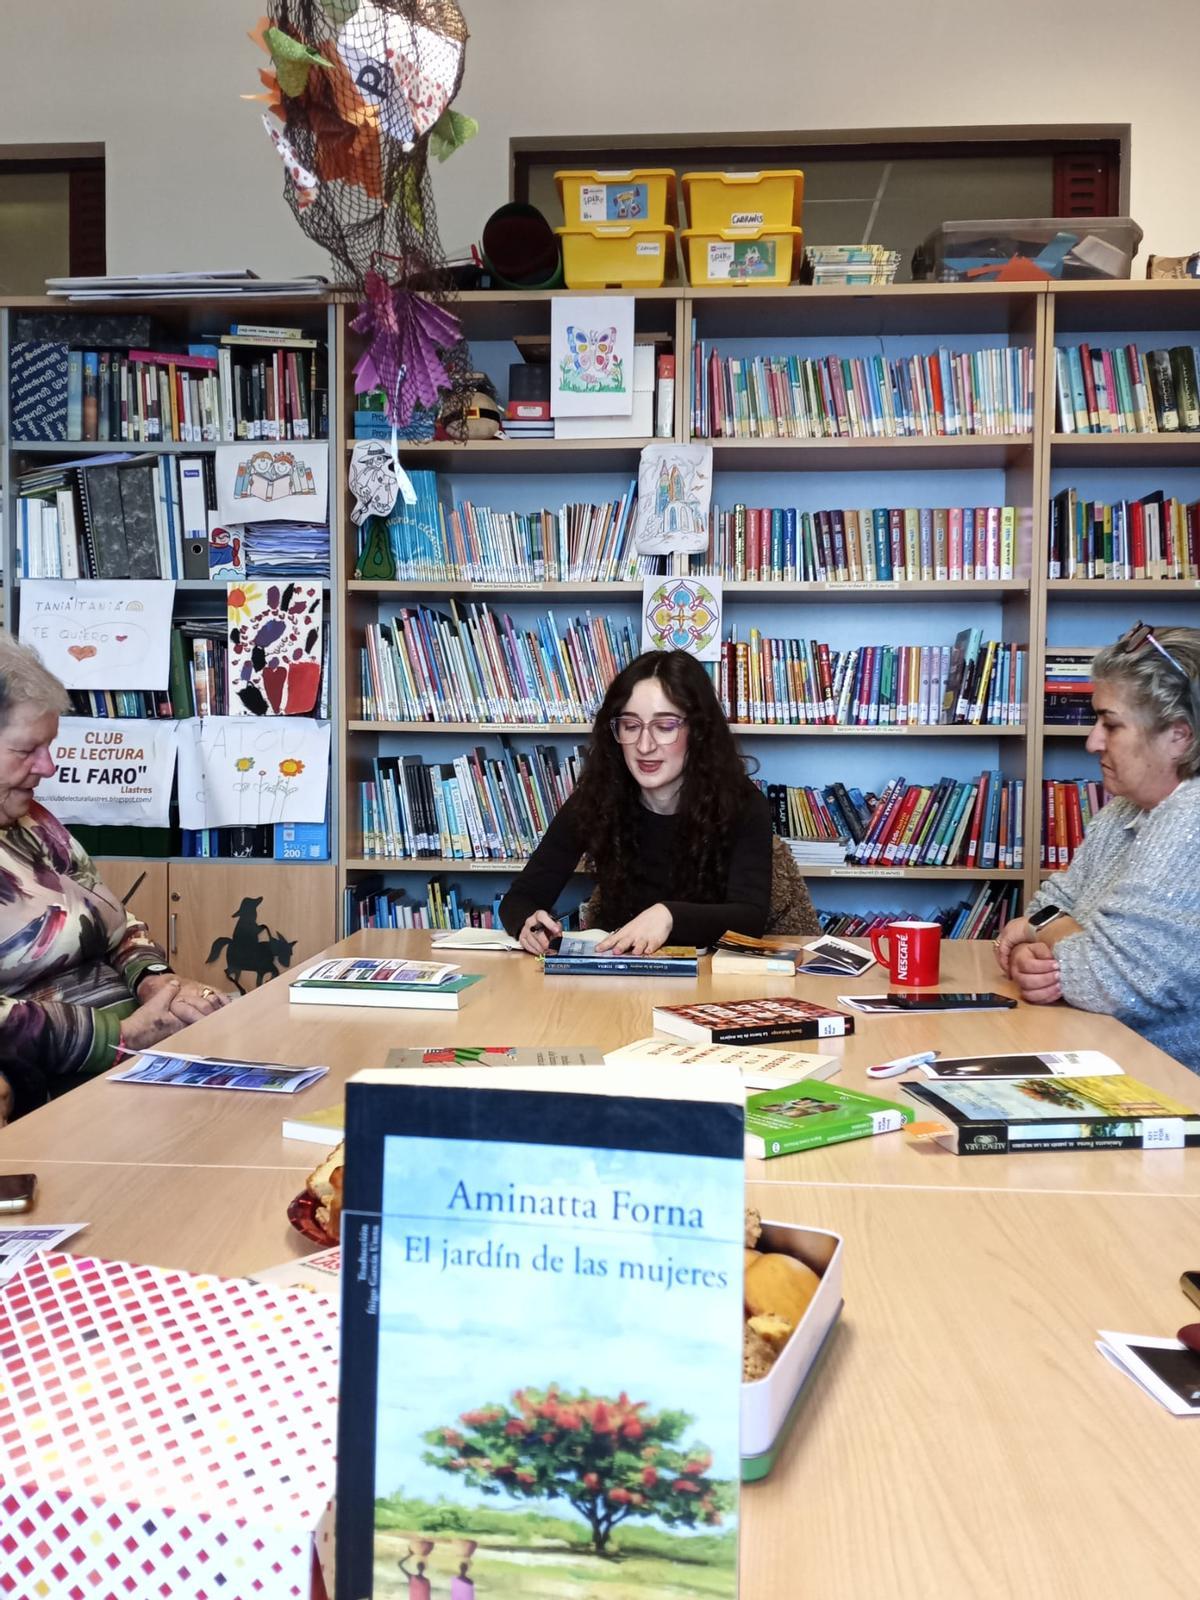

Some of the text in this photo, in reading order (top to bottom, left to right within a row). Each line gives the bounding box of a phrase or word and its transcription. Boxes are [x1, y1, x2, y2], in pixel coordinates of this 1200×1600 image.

[84, 731, 124, 745] CLUB
[56, 747, 145, 761] DE LECTURA
[86, 765, 148, 785] FARO"
[120, 785, 153, 794] Llastres
[284, 849, 301, 858] 200
[896, 933, 909, 980] NESCAFÉ
[964, 1142, 1006, 1152] ALFAGUARA
[446, 1178, 705, 1230] Aminatta Forna
[404, 1235, 729, 1292] El jardín de las mujeres
